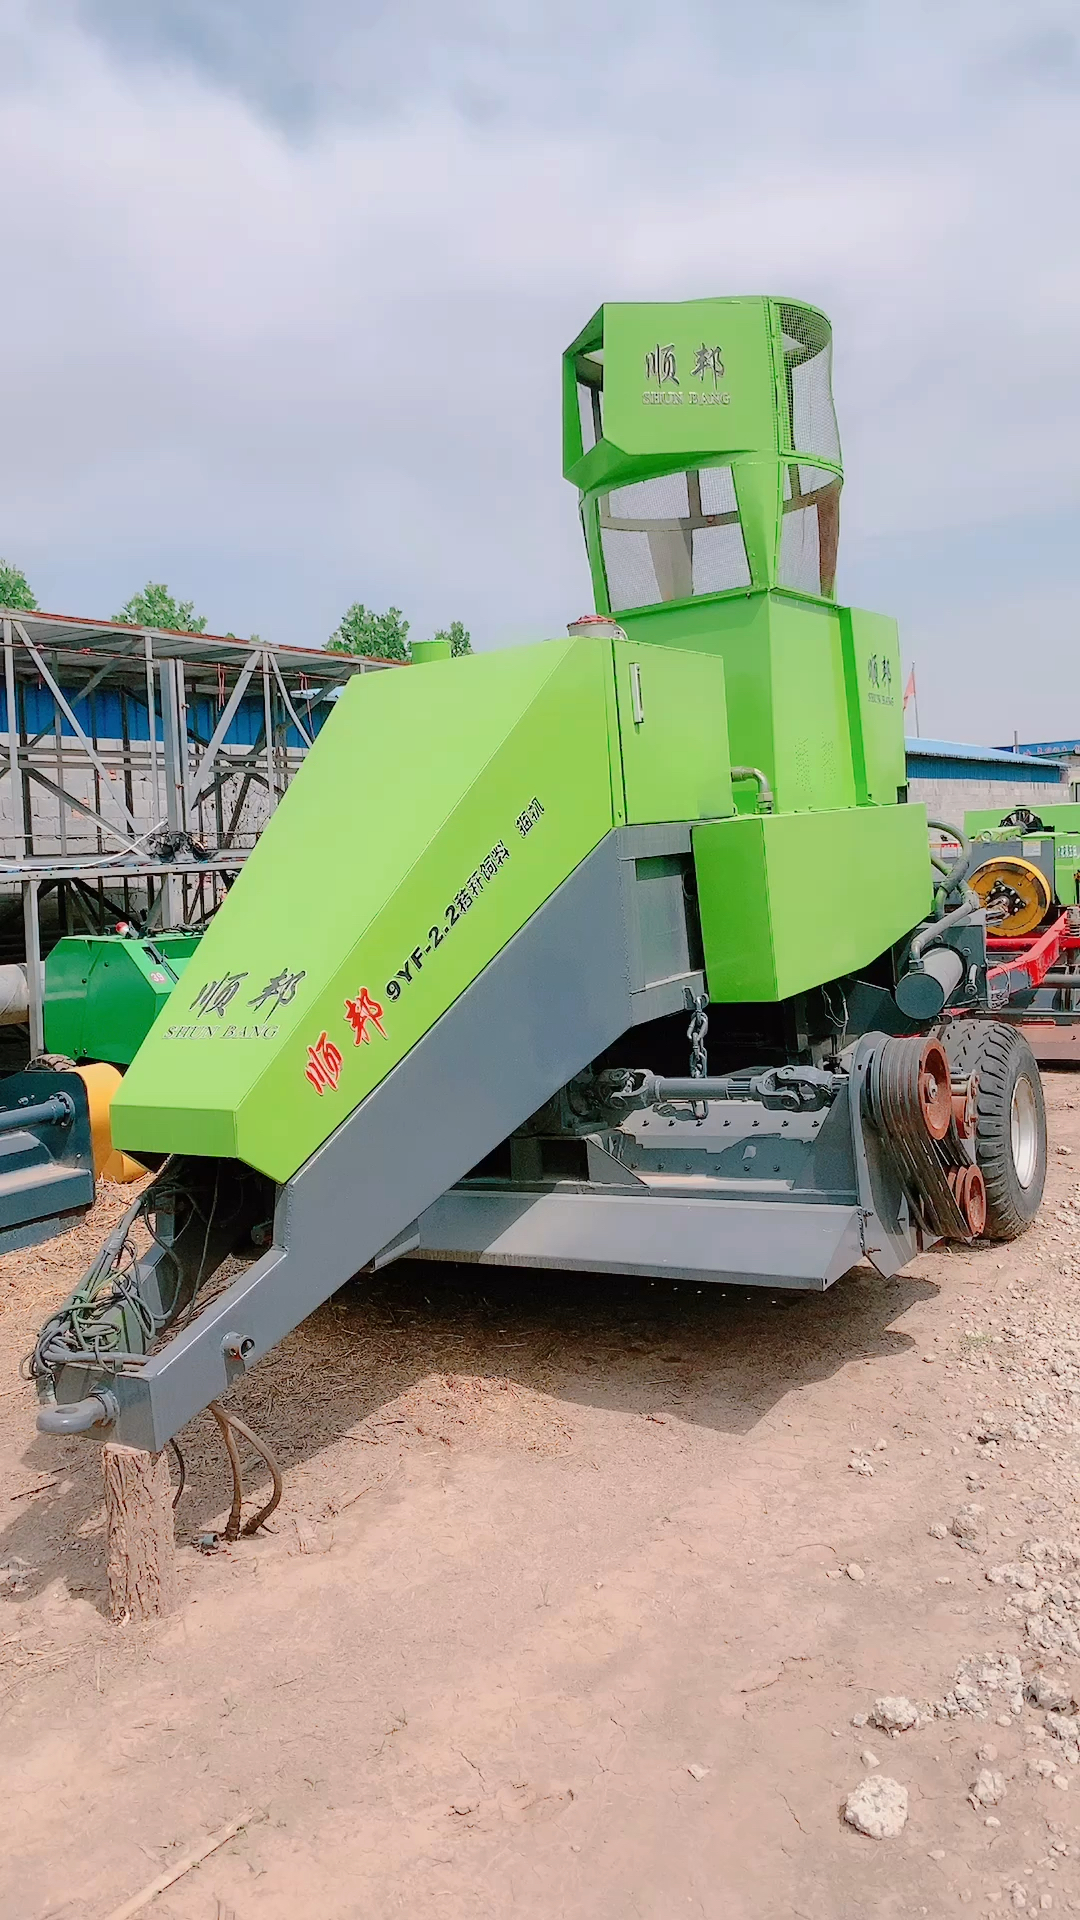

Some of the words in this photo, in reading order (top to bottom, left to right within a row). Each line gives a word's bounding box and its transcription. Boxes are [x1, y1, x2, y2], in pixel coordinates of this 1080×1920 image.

[645, 342, 725, 390] 顺邦
[642, 391, 683, 405] SHUN
[689, 391, 731, 406] BANG
[150, 971, 166, 983] 39
[188, 967, 306, 1024] 顺邦
[162, 1024, 220, 1040] SHUN
[219, 1024, 280, 1040] BANG
[305, 986, 388, 1096] 顺邦
